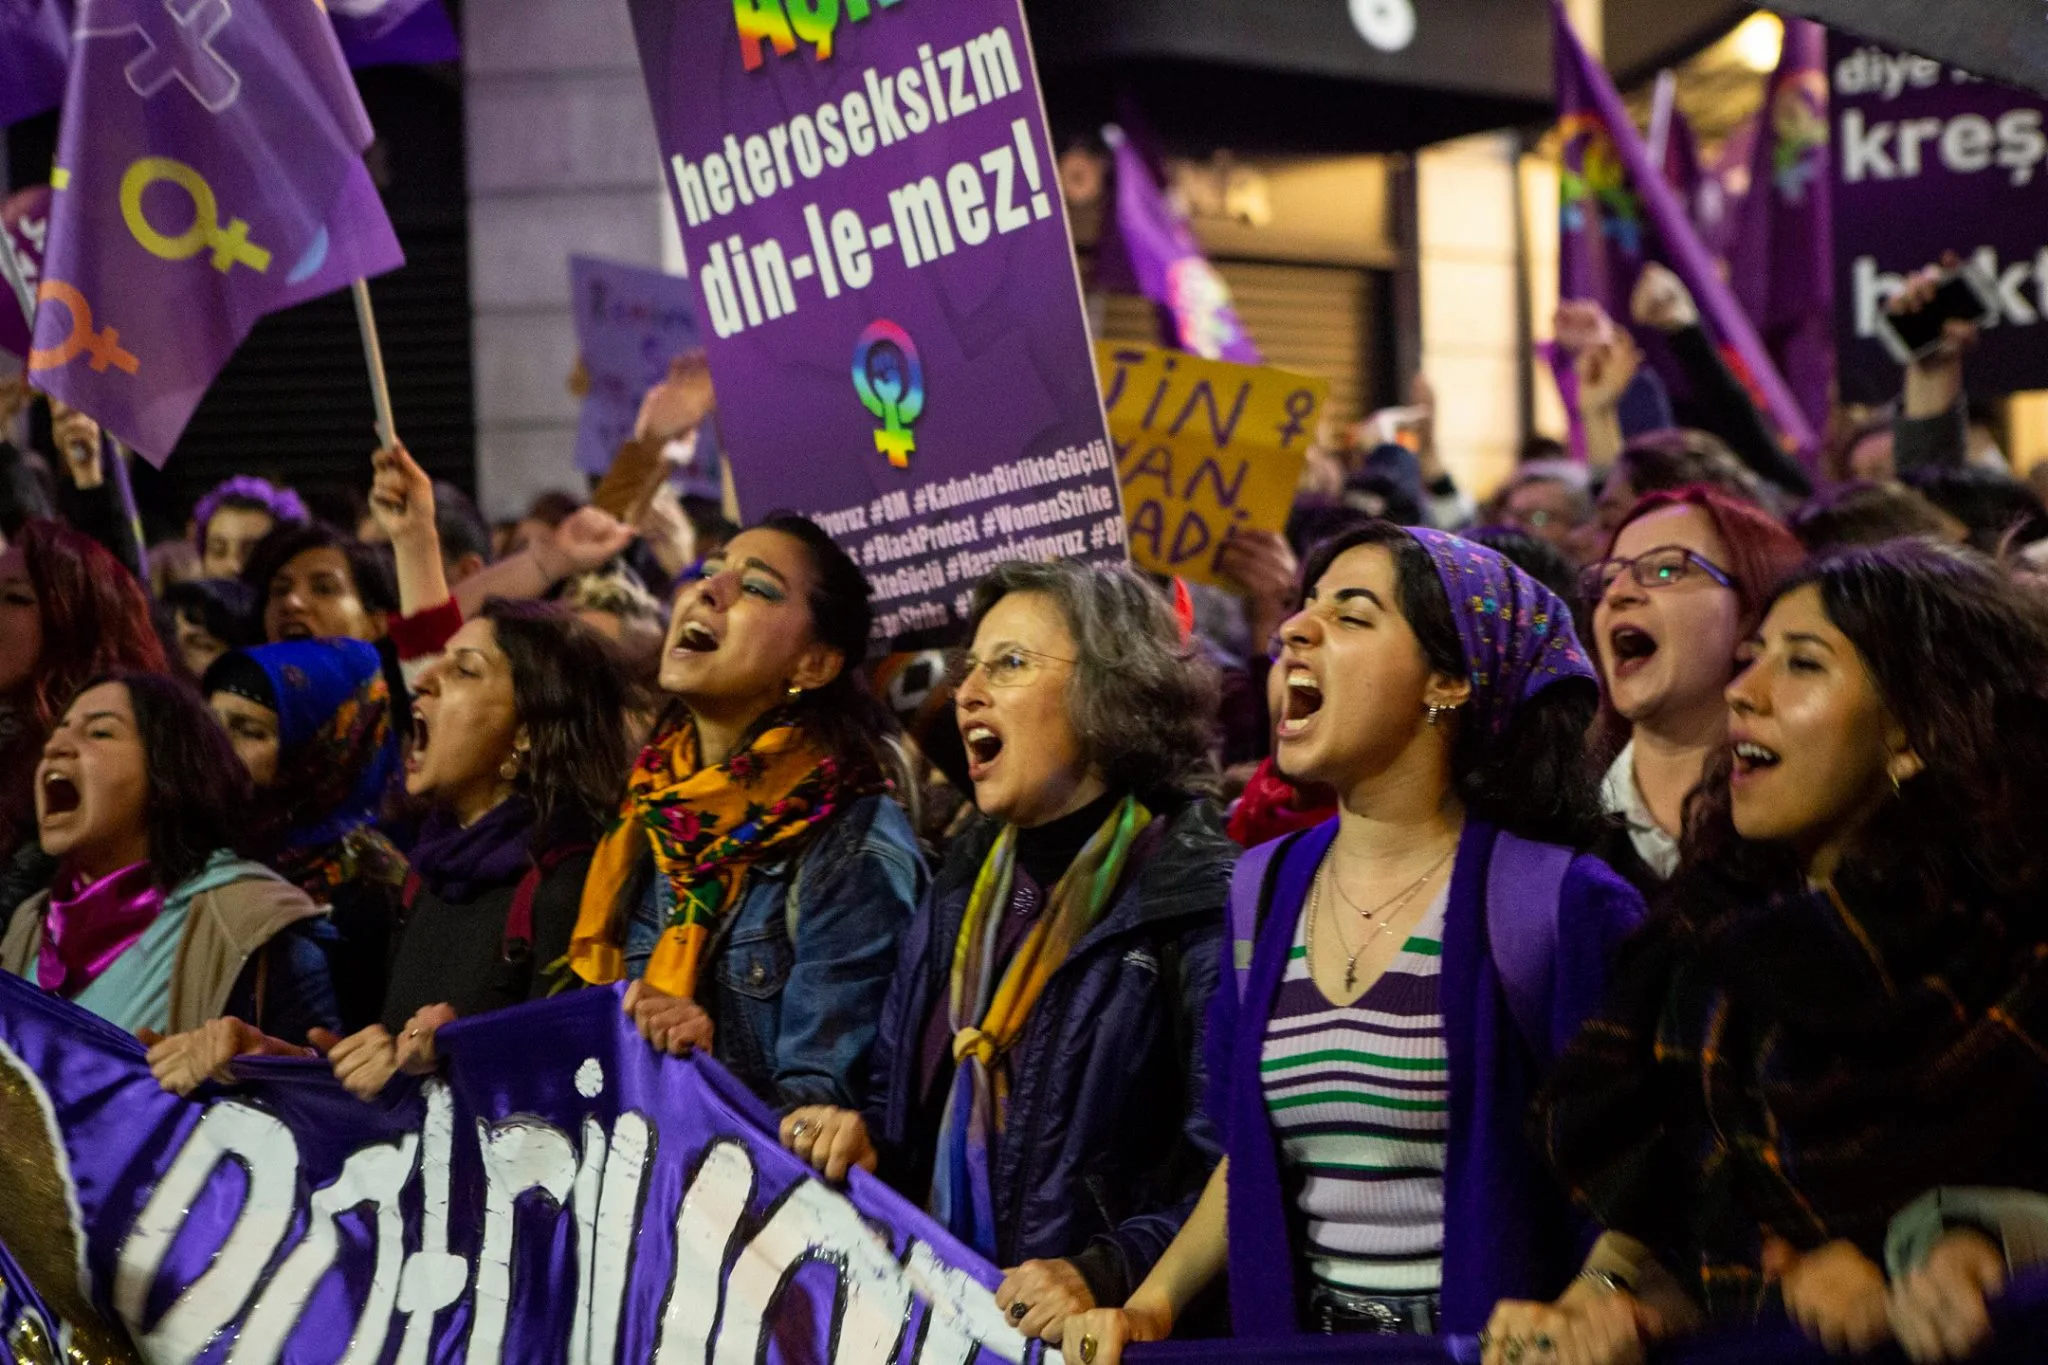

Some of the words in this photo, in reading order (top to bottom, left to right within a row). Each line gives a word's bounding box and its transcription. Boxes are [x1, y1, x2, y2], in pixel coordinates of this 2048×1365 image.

[1833, 45, 1941, 100] diye
[671, 26, 1023, 228] heteroseksizm
[1841, 107, 2047, 187] kreş
[701, 118, 1053, 339] din-le-mez!
[863, 515, 979, 566] #BlackProtest
[982, 485, 1113, 539] #WomenStrike
[870, 490, 911, 523] #8M
